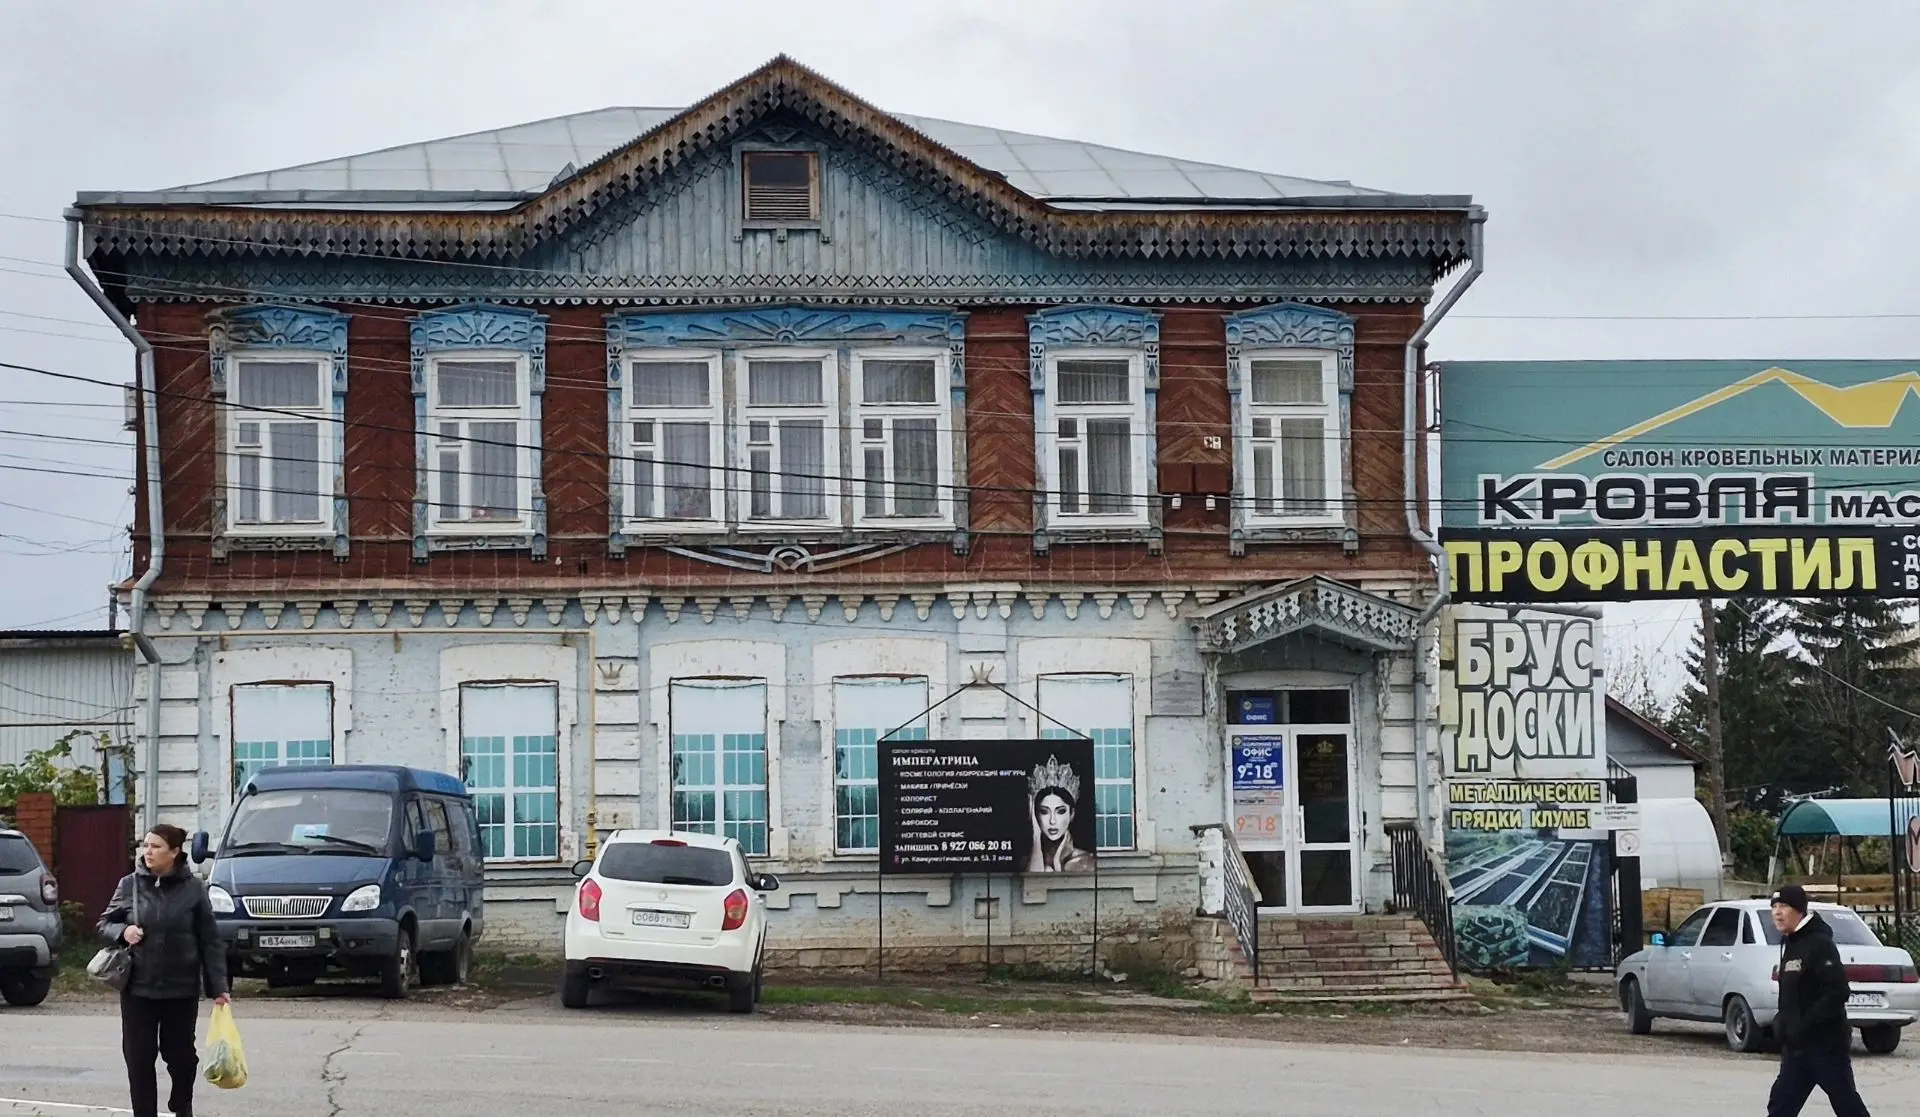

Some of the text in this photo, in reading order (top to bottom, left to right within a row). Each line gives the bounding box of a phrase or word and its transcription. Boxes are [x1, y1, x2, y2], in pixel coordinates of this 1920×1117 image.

[1603, 449, 1674, 467] САЛОН
[1681, 449, 1822, 466] КРОВЕЛЬНЫХ
[1482, 475, 1810, 522] КРОВЛЯ
[1444, 537, 1877, 592] ПРОФНАСТИЛ
[1454, 619, 1593, 688] БРУС
[1454, 688, 1595, 772] ДОСКИ
[893, 756, 979, 766] ИМПЕРАТРИЦА
[1242, 748, 1272, 757] ОФИС
[1450, 783, 1600, 804] МЕТАЛЛИЧЕСКИЕ
[1450, 809, 1523, 831] ГРЯДКИ
[901, 830, 937, 838] НОГТЕВОЙ
[941, 841, 948, 851] 8
[950, 841, 967, 851] 927
[987, 840, 999, 850] 20
